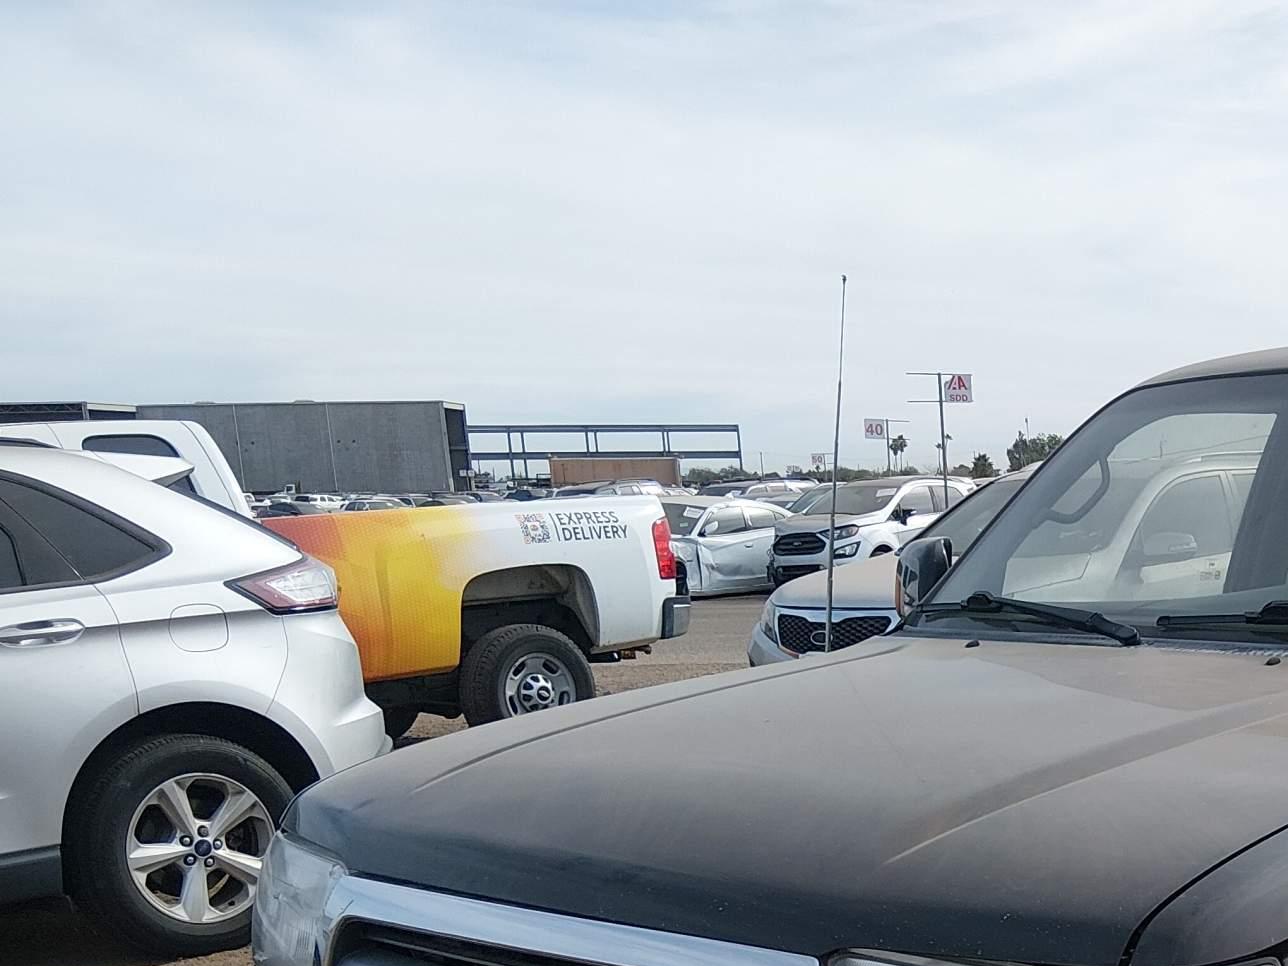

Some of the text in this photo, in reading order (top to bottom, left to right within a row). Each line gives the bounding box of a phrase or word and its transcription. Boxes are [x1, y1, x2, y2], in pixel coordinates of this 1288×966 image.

[865, 423, 884, 436] 40
[555, 511, 620, 526] EXPRESS
[562, 524, 628, 541] DELIVERY
